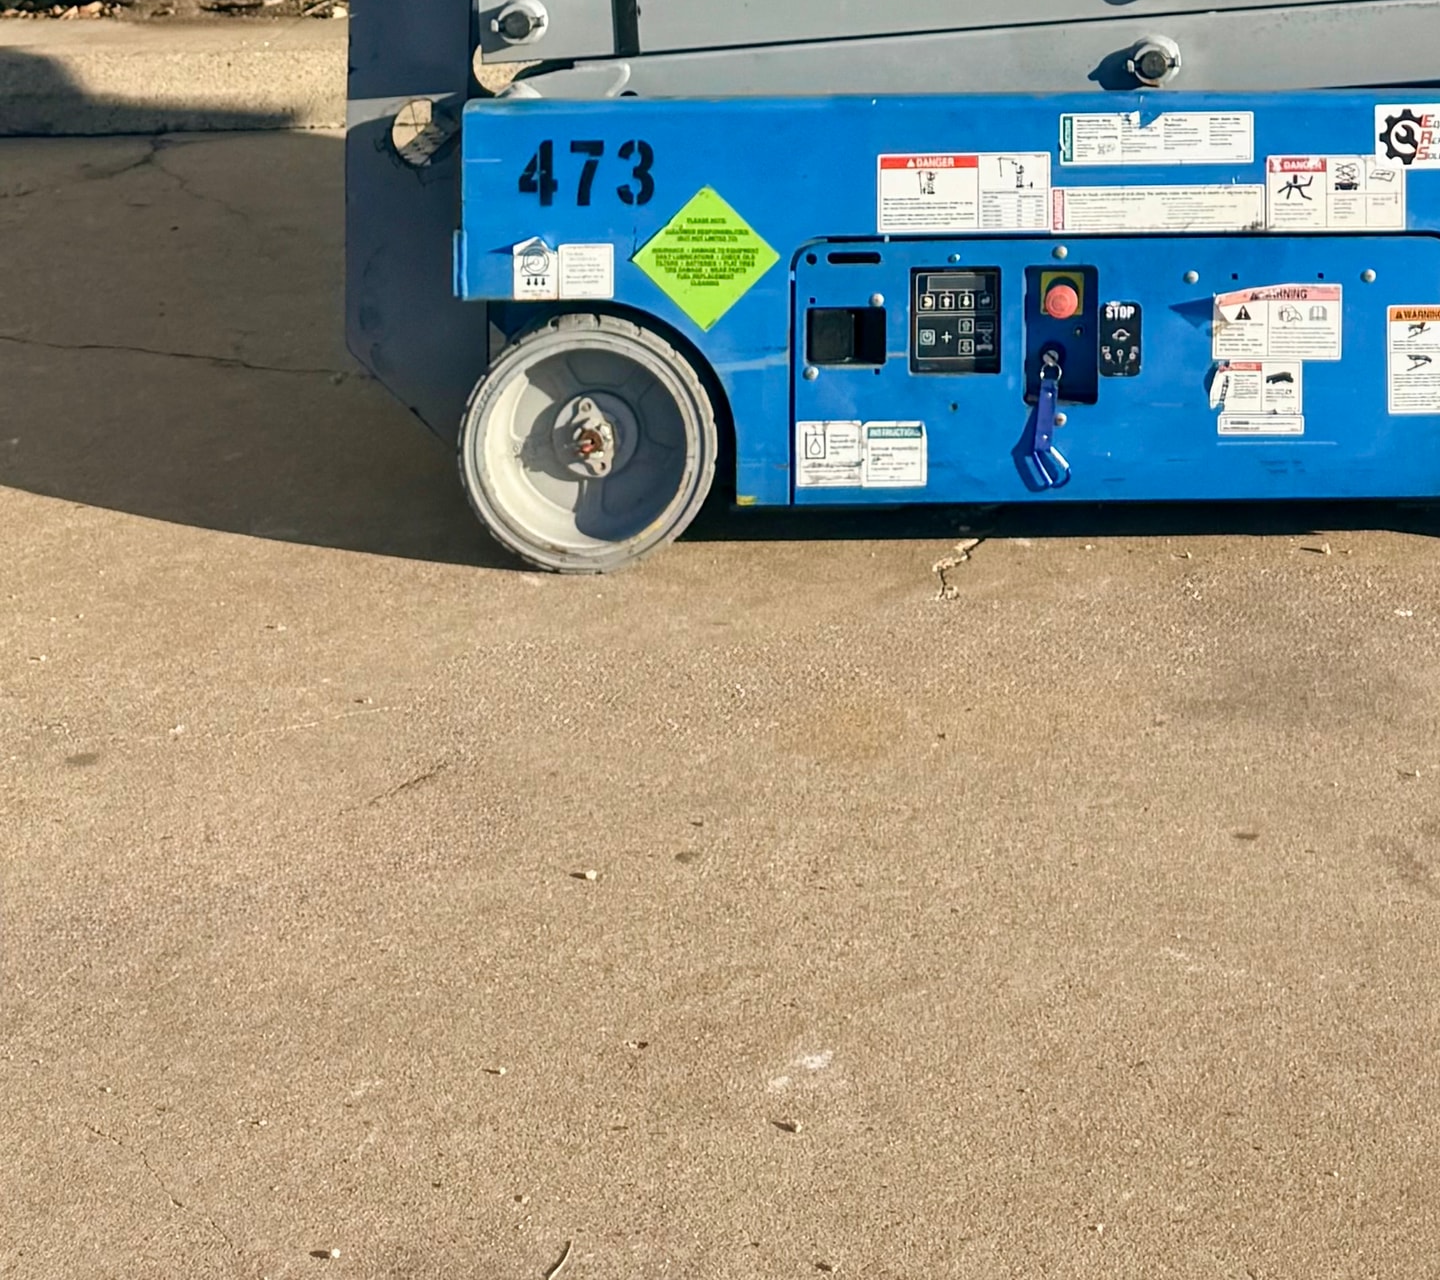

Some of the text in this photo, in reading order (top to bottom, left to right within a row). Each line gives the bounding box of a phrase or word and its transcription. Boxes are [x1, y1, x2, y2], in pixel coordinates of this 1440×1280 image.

[916, 157, 955, 168] DANGER
[518, 139, 655, 207] 473
[1105, 305, 1136, 320] STOP
